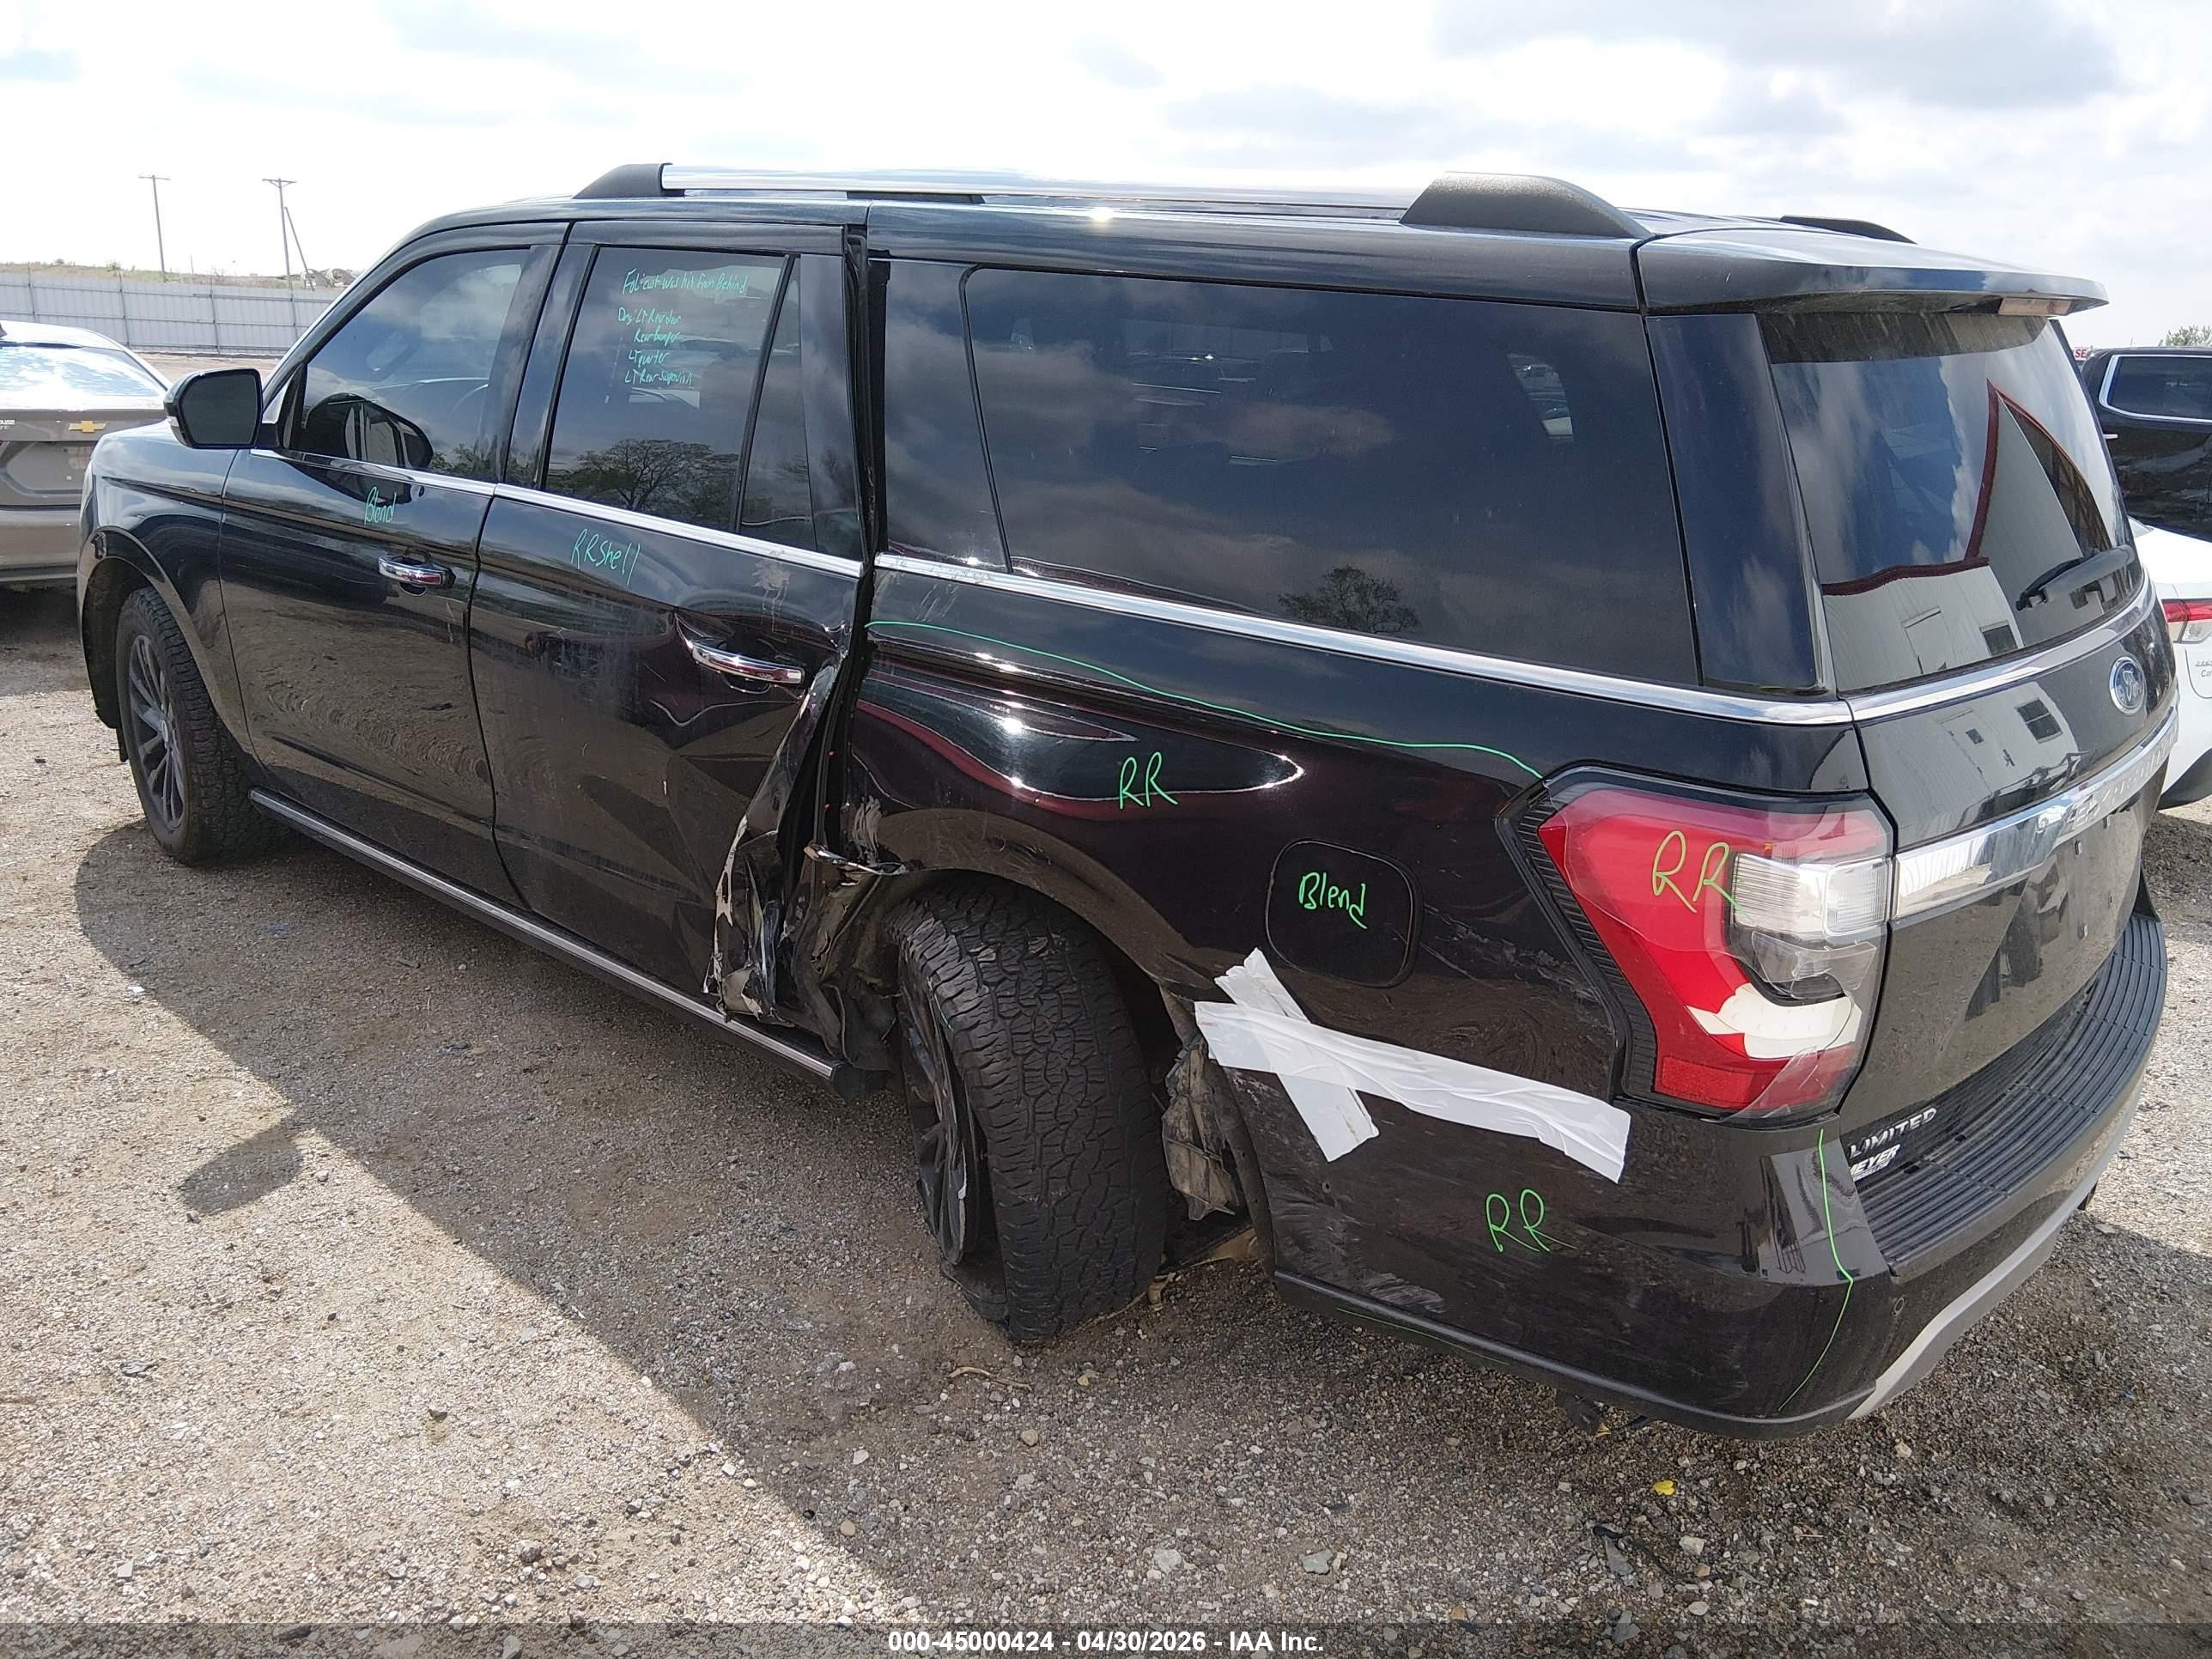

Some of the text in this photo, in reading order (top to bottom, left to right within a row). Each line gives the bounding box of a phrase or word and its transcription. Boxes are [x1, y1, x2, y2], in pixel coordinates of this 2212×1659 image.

[1118, 751, 1178, 810] RR
[1297, 871, 1368, 930] Blend
[1651, 830, 1748, 915] RR
[1849, 1107, 1938, 1159] LIMITED
[1486, 1188, 1578, 1252] RR
